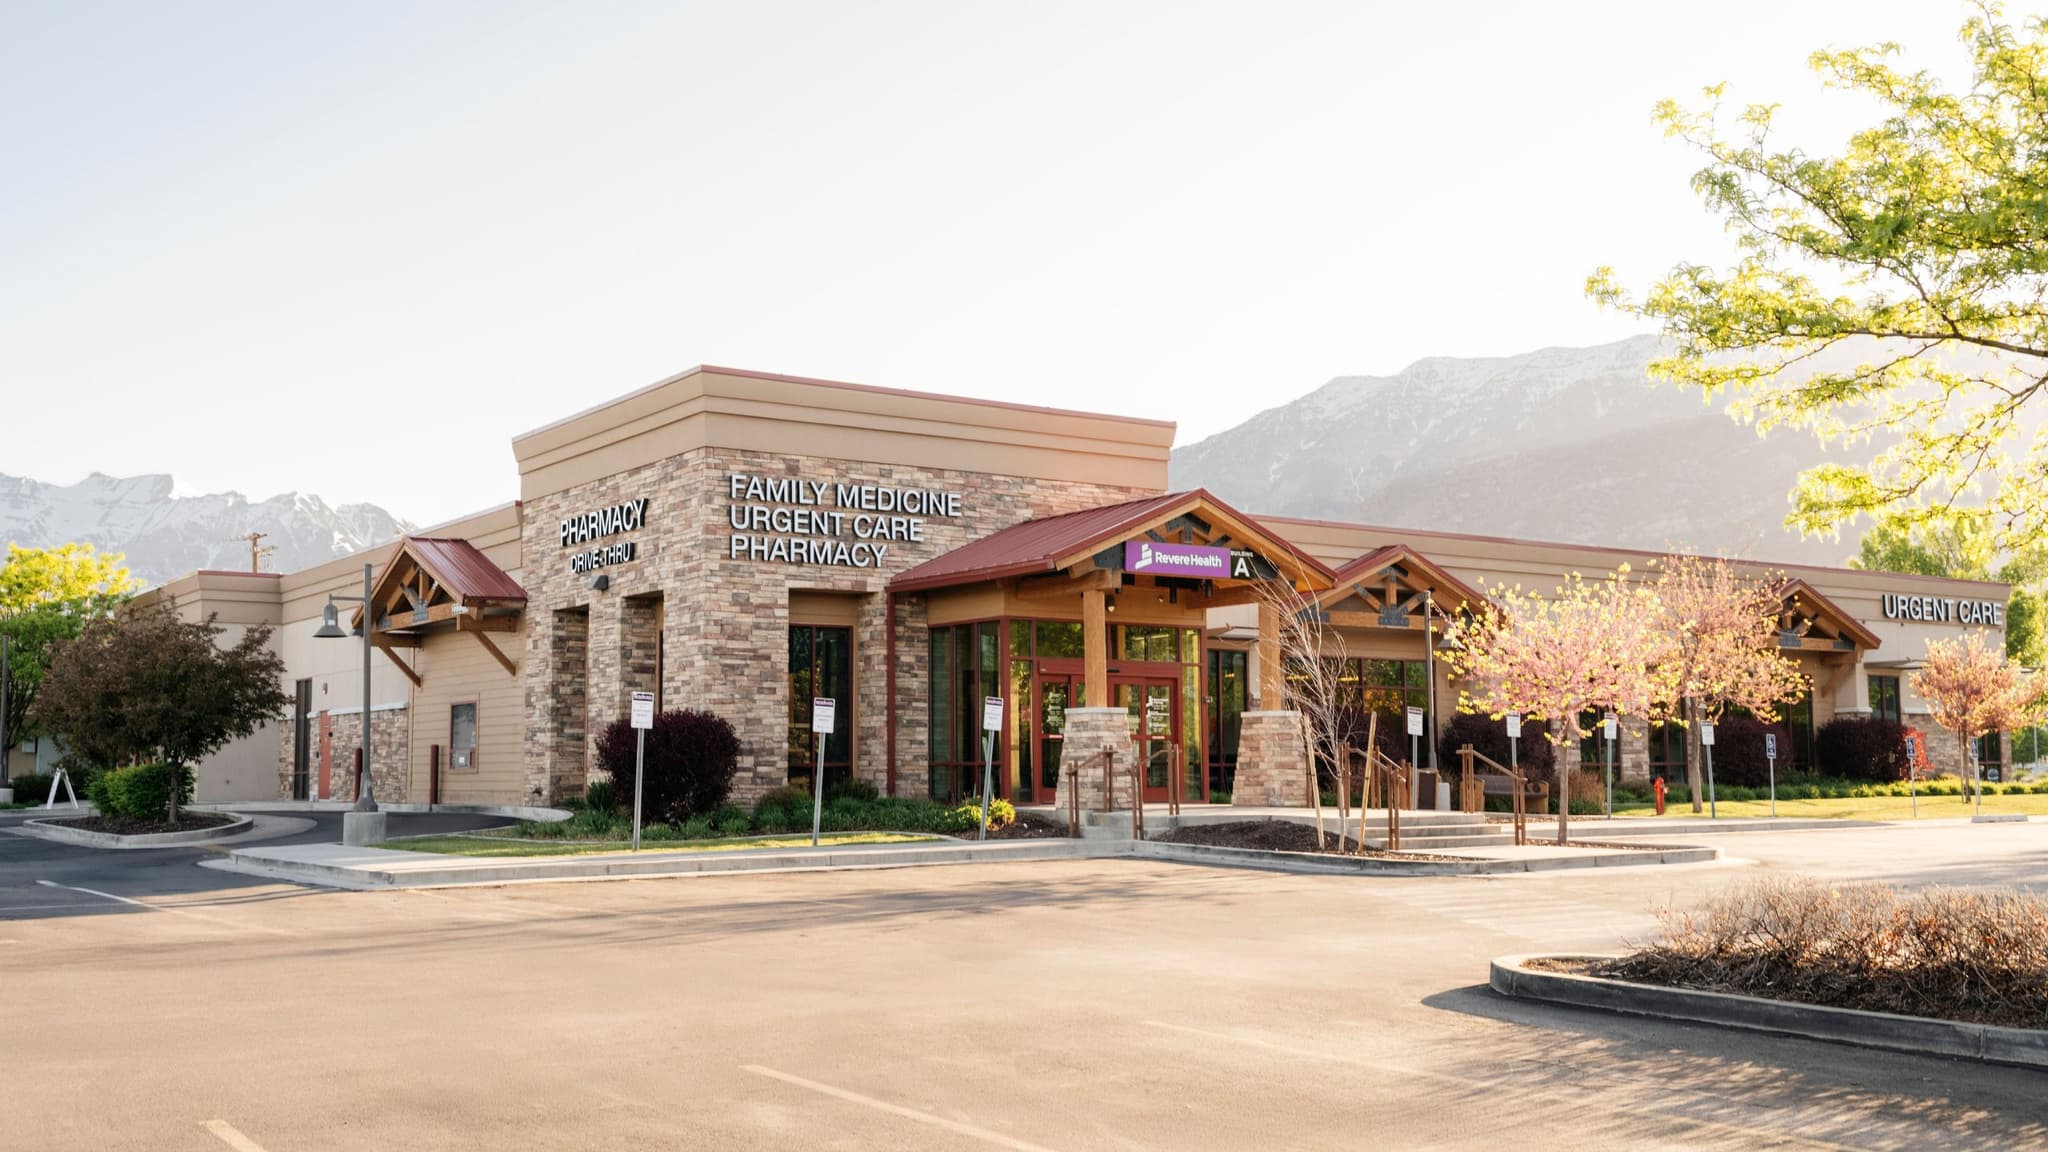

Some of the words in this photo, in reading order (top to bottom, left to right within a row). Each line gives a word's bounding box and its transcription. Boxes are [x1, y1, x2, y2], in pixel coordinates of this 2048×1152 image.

[731, 475, 828, 506] FAMILY
[837, 484, 962, 517] MEDICINE
[560, 498, 646, 548] PHARMACY
[730, 504, 846, 536] URGENT
[853, 514, 924, 543] CARE
[571, 541, 632, 574] DRIVE-THRU
[731, 534, 888, 568] PHARMACY
[1234, 557, 1250, 577] A
[1884, 594, 1954, 622] URGENT
[1959, 600, 2003, 625] CARE
